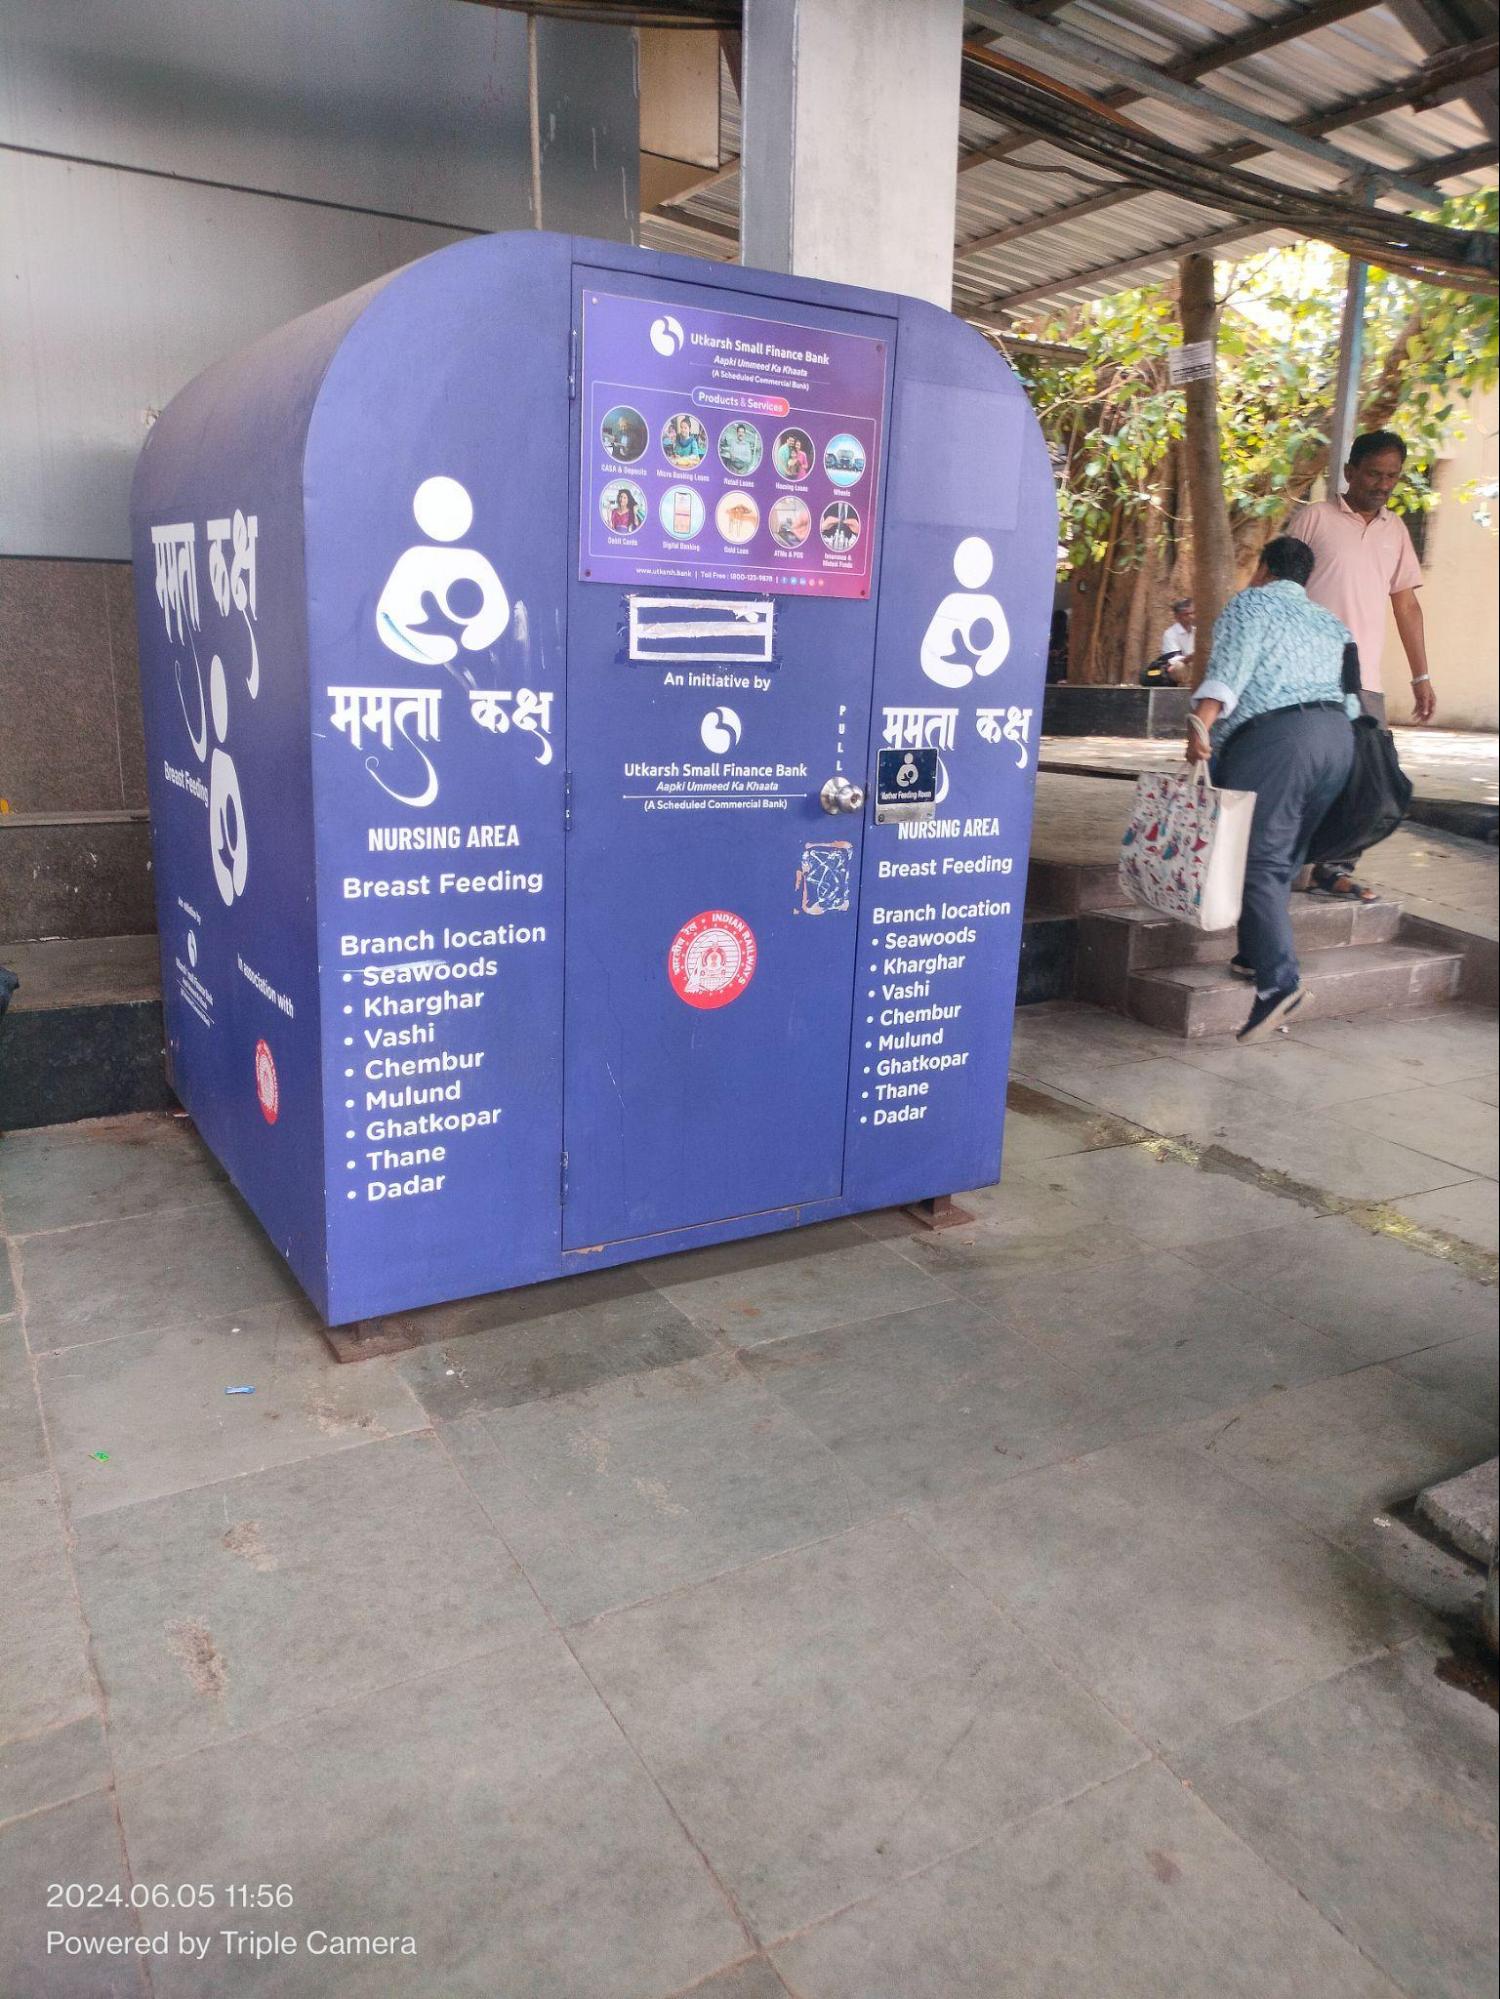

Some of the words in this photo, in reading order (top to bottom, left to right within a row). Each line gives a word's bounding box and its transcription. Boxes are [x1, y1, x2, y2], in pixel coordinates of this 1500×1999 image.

[690, 333, 733, 350] Utkarsh
[735, 340, 763, 355] Small
[765, 345, 804, 360] Finance
[805, 351, 830, 365] Bank
[713, 355, 736, 367] Aapki
[737, 358, 770, 373] Ummeed
[771, 364, 781, 373] Ka
[782, 366, 808, 377] Khaata
[721, 371, 754, 383] Scheduled
[755, 376, 791, 388] Commercial
[699, 391, 739, 407] Products
[740, 399, 746, 407] &
[747, 399, 784, 412] Services
[664, 672, 684, 686] An
[754, 674, 771, 691] by
[327, 686, 442, 807] ममता
[469, 688, 554, 765] कक्ष
[976, 706, 1033, 769] कक्ष
[624, 763, 679, 777] Utkarsh
[682, 762, 720, 777] Small
[723, 763, 773, 777] Finance
[776, 763, 807, 777] Bank
[164, 760, 185, 789] Breast
[185, 771, 208, 808] Feeding
[656, 780, 685, 793] Aapki
[687, 781, 730, 791] Ummeed
[731, 781, 744, 791] Ka
[746, 781, 778, 791] Khaata
[644, 800, 655, 812] (A
[657, 799, 706, 810] Scheduled
[708, 799, 761, 809] Commercial
[762, 799, 787, 810] Bank)
[368, 825, 461, 851] NURSING
[466, 824, 520, 848] AREA
[898, 819, 960, 840] NURSING
[963, 817, 1000, 837] AREA
[878, 859, 937, 878] Breast
[943, 855, 1013, 875] Feeding
[343, 875, 431, 899] Breast
[440, 870, 543, 894] Feeding
[873, 904, 935, 924] Branch
[942, 900, 1011, 920] location
[340, 930, 434, 956] Branch
[443, 924, 546, 949] location
[712, 914, 744, 931] INDIAN
[738, 931, 755, 984] RAILWAYS
[885, 926, 976, 949] Seawoods
[363, 956, 498, 987] Seawoods
[883, 953, 966, 975] Kharghar
[243, 962, 277, 1004] association
[277, 994, 294, 1019] with
[882, 980, 930, 1000] Vashi
[364, 990, 485, 1018] Kharghar
[880, 1003, 961, 1026] Chembur
[364, 1022, 435, 1049] Vashi
[878, 1028, 944, 1051] Mulund
[365, 1051, 485, 1080] Chembur
[876, 1051, 969, 1077] Ghatkopar
[366, 1080, 461, 1112] Mulund
[875, 1080, 929, 1101] Thane
[366, 1108, 502, 1141] Ghatkopar
[873, 1104, 927, 1126] Dadar
[366, 1145, 446, 1171] Thane
[367, 1173, 446, 1202] Dadar
